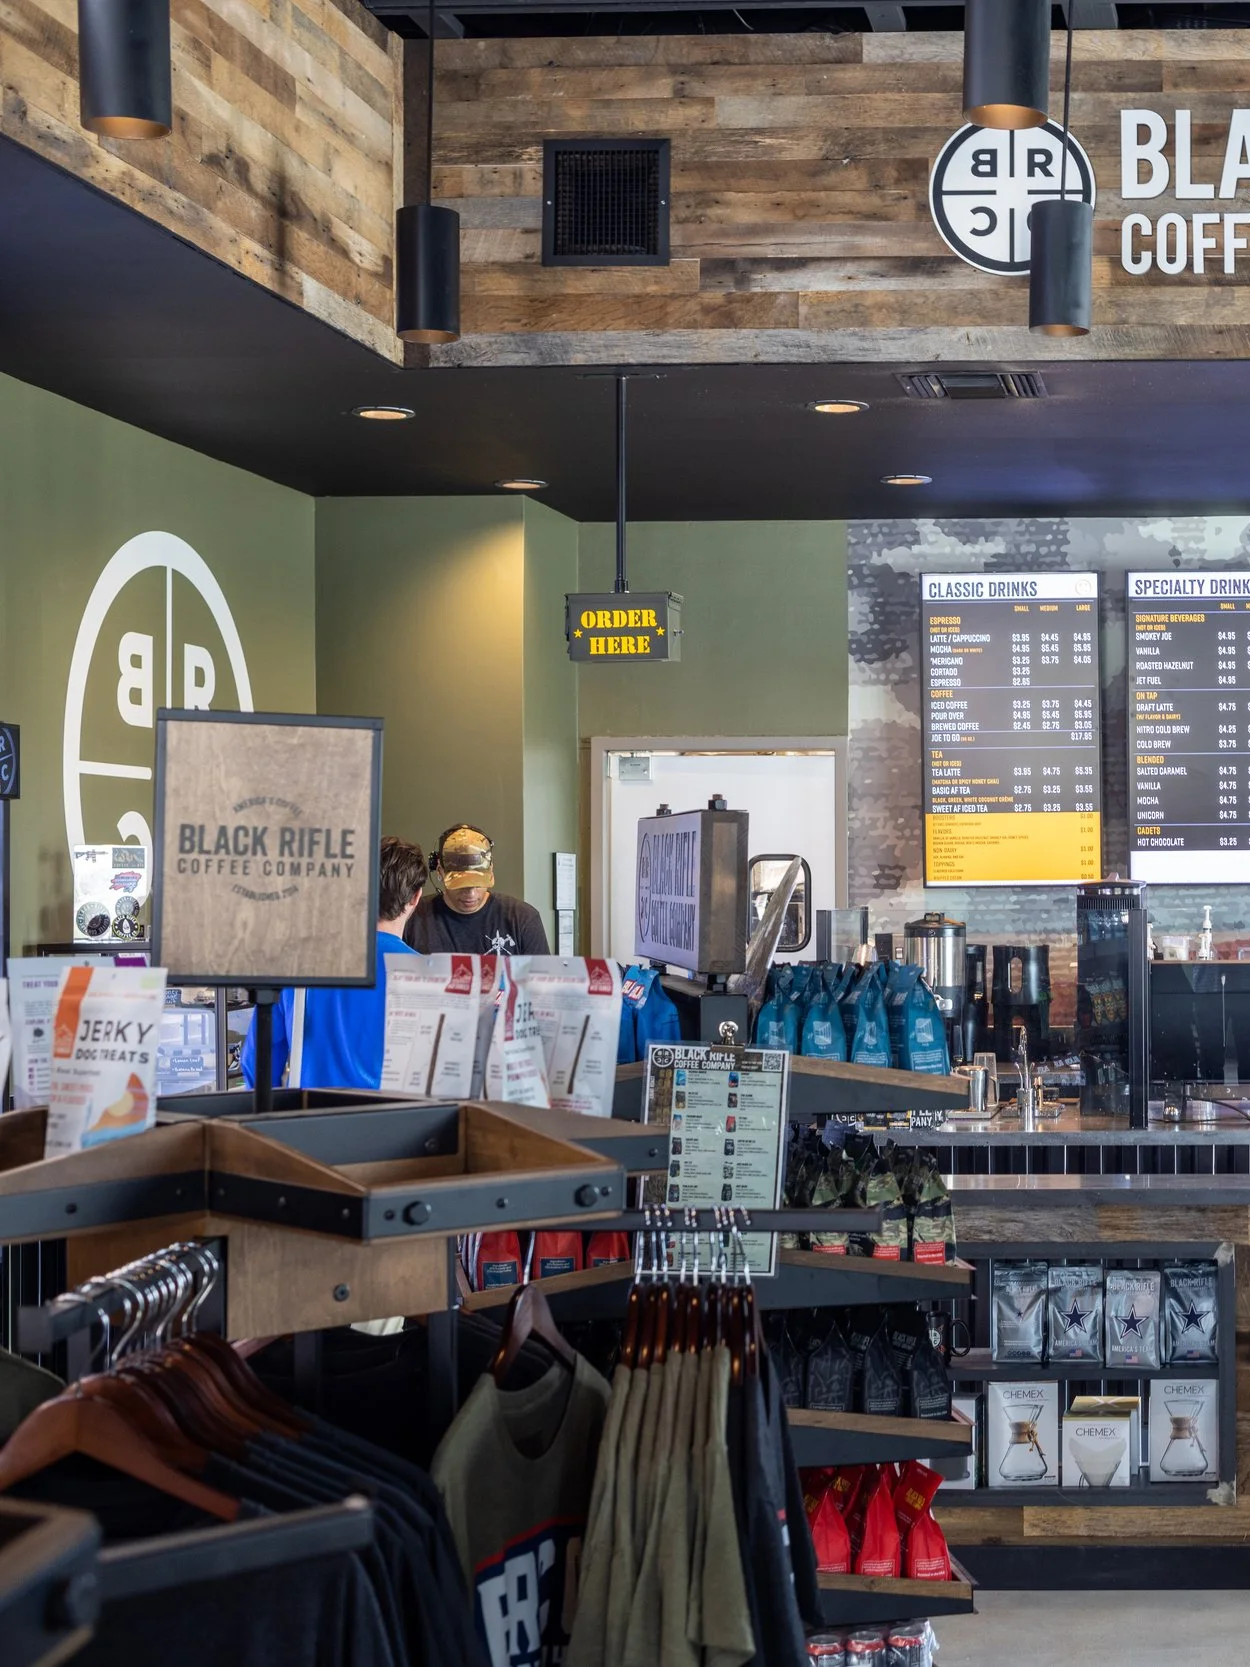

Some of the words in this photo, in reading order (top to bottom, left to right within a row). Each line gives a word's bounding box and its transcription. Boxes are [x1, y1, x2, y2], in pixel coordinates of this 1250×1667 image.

[928, 581, 984, 598] CLASSIC
[988, 580, 1038, 598] DRINKS
[1135, 578, 1205, 595] SPECIALTY
[580, 609, 657, 629] ORDER
[930, 616, 961, 624] ESPRESSO
[1136, 614, 1168, 622] SIGNATURE
[1170, 614, 1204, 622] BEVERAGES
[930, 634, 947, 643] LATTE
[952, 634, 991, 642] CAPPUCCINO
[1136, 632, 1160, 640] SMOKEY
[1161, 632, 1172, 640] JOE
[590, 636, 650, 655] HERE
[1136, 647, 1160, 656] VANILLA
[1136, 662, 1163, 670] ROASTED
[1164, 662, 1193, 670] HAZELNUT
[930, 668, 958, 676] CORTADO
[1136, 676, 1146, 684] JET
[1147, 676, 1161, 684] FUEL
[930, 690, 954, 698] COFFEE
[931, 701, 945, 710] ICED
[946, 701, 968, 709] COFFEE
[1136, 704, 1156, 712] DRAFT
[1156, 703, 1173, 711] LATTE
[931, 712, 948, 720] POUR
[948, 712, 964, 720] OVER
[932, 722, 956, 731] BREWED
[958, 722, 980, 730] COFFEE
[1136, 726, 1154, 734] NITRO
[1155, 726, 1171, 734] COLD
[1172, 725, 1190, 734] BREW
[932, 734, 942, 742] JOE
[943, 734, 950, 742] TO
[952, 733, 960, 742] GO
[932, 750, 943, 758] TEA
[932, 768, 943, 776] TEA
[944, 768, 960, 776] LATTE
[1137, 767, 1158, 776] SALTED
[1160, 766, 1187, 775] CARAMEL
[932, 786, 950, 795] BASIC
[951, 786, 958, 794] AF
[960, 786, 970, 794] TEA
[932, 805, 952, 813] SWEET
[962, 804, 976, 812] ICED
[977, 804, 988, 812] TEA
[1137, 812, 1164, 820] UNICORN
[1137, 826, 1160, 834] CADETS
[178, 823, 269, 857] BLACK
[279, 826, 355, 860] RIFLE
[1138, 838, 1150, 846] HOT
[1150, 838, 1184, 846] CHOCOLATE
[177, 858, 251, 876] COFFEE
[262, 860, 355, 879] COMPANY
[79, 1019, 153, 1045] JERKY
[75, 1049, 97, 1061] DOG
[675, 1048, 707, 1061] BLACK
[674, 1060, 700, 1069] COFFEE
[701, 1061, 736, 1071] COMPANY
[1112, 1282, 1135, 1292] BLACK
[1136, 1282, 1155, 1292] RIFLE
[1003, 1389, 1044, 1400] CHEMEX
[1164, 1385, 1205, 1395] CHEMEX
[1075, 1427, 1117, 1438] CHEMEX
